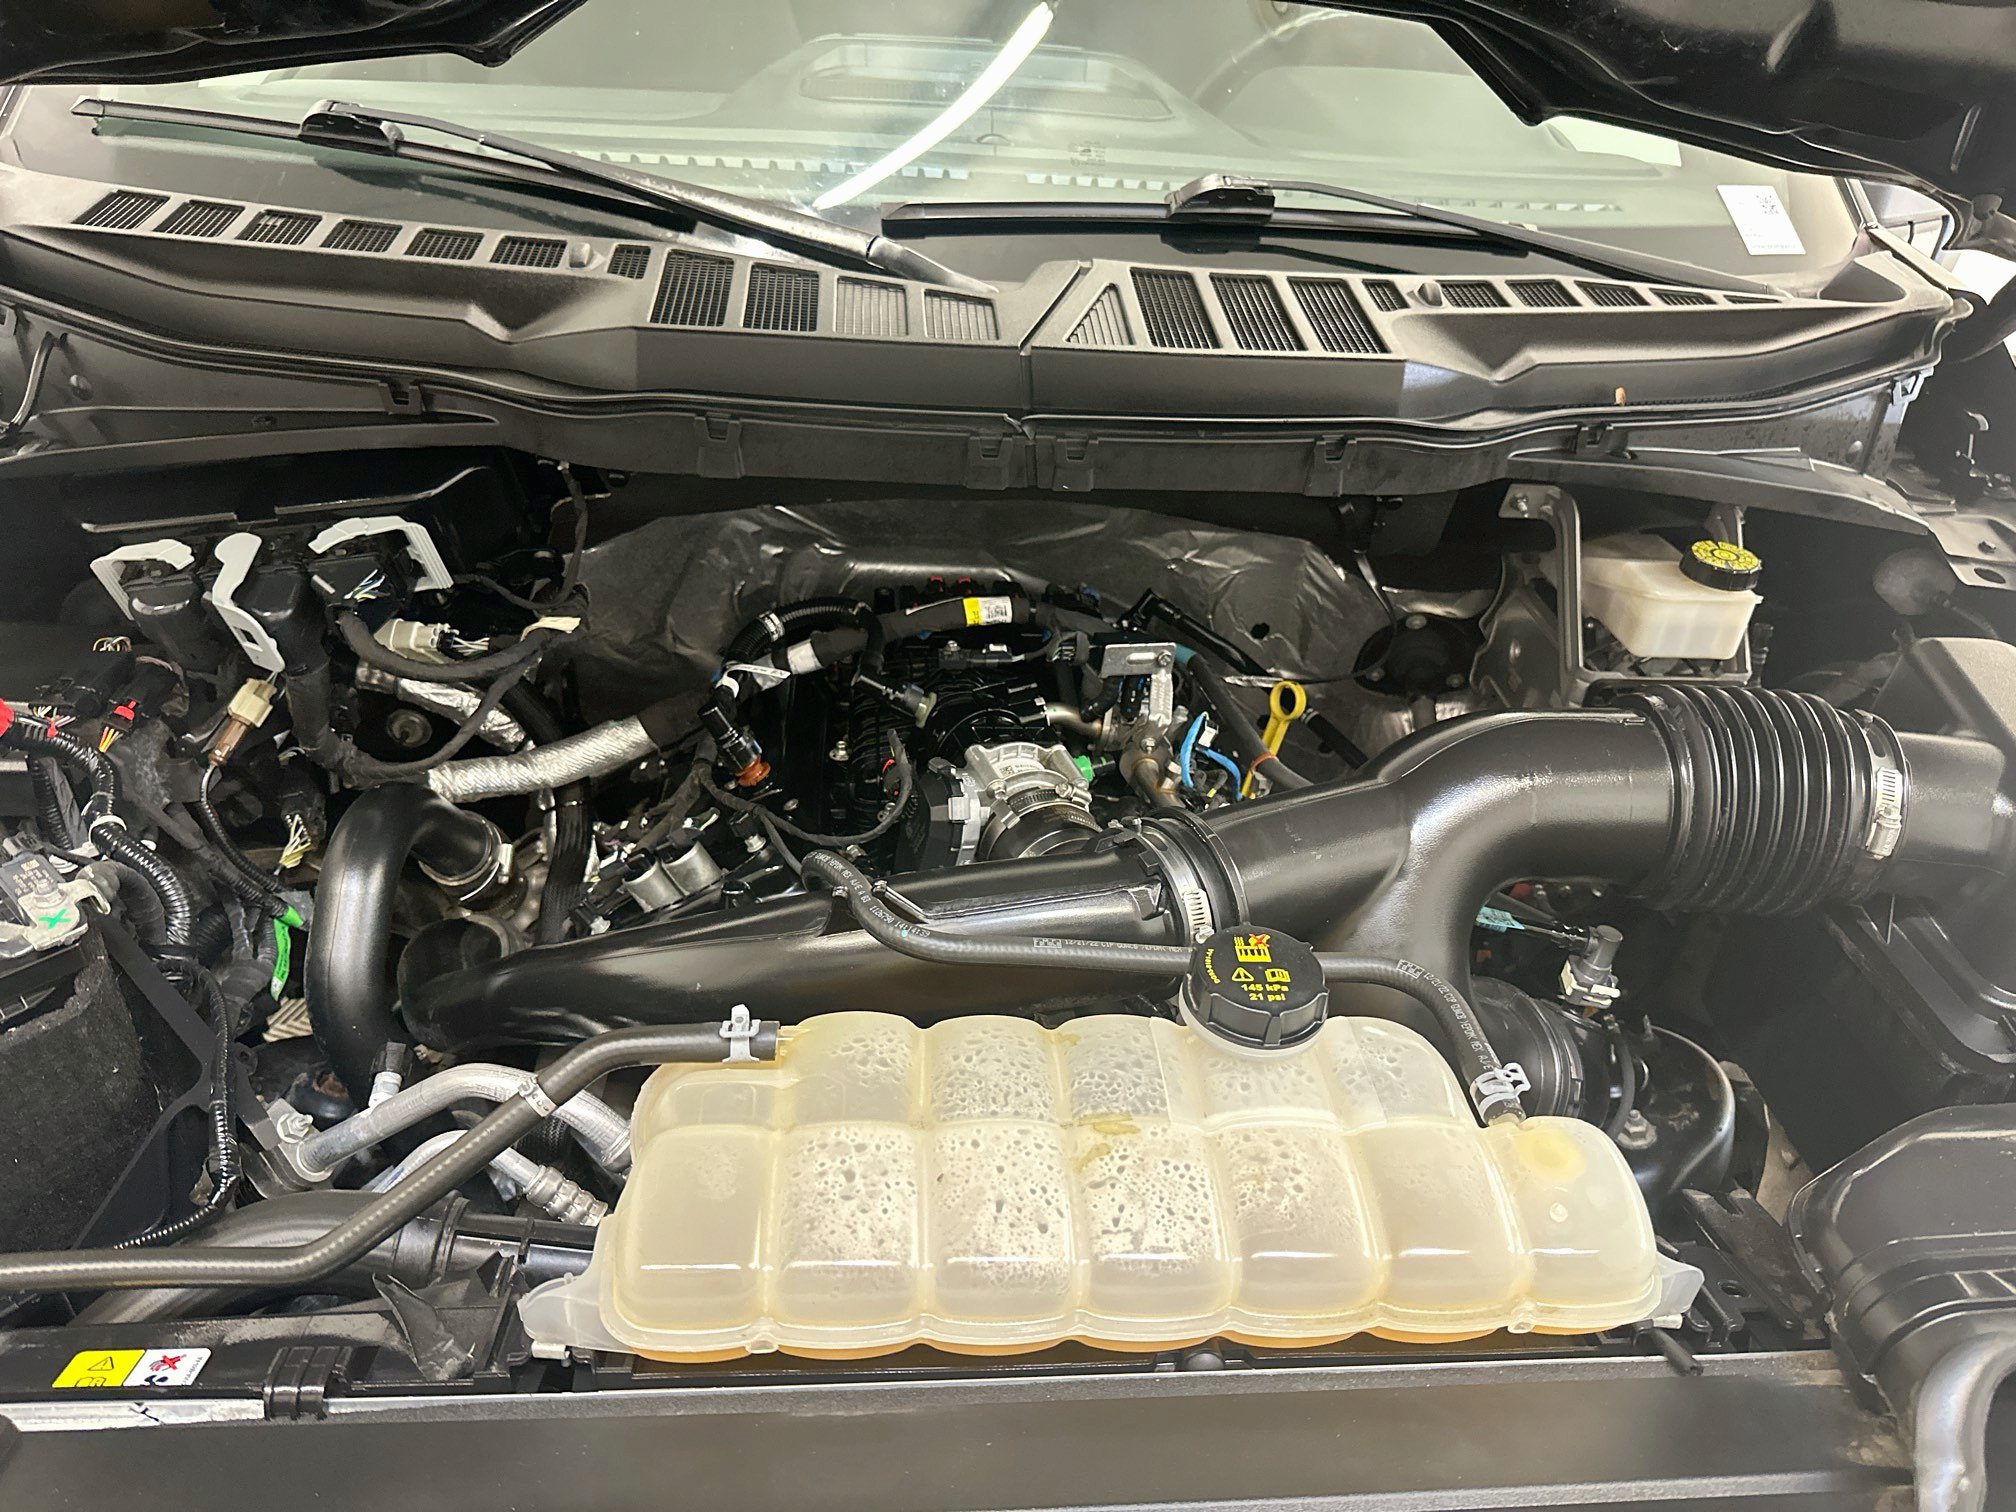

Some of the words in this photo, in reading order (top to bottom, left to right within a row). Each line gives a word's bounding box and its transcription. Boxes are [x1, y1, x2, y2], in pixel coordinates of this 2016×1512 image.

[1241, 983, 1263, 992] 145
[1266, 983, 1289, 992] kPa
[1249, 992, 1264, 1001] 21
[1267, 993, 1286, 1002] psi
